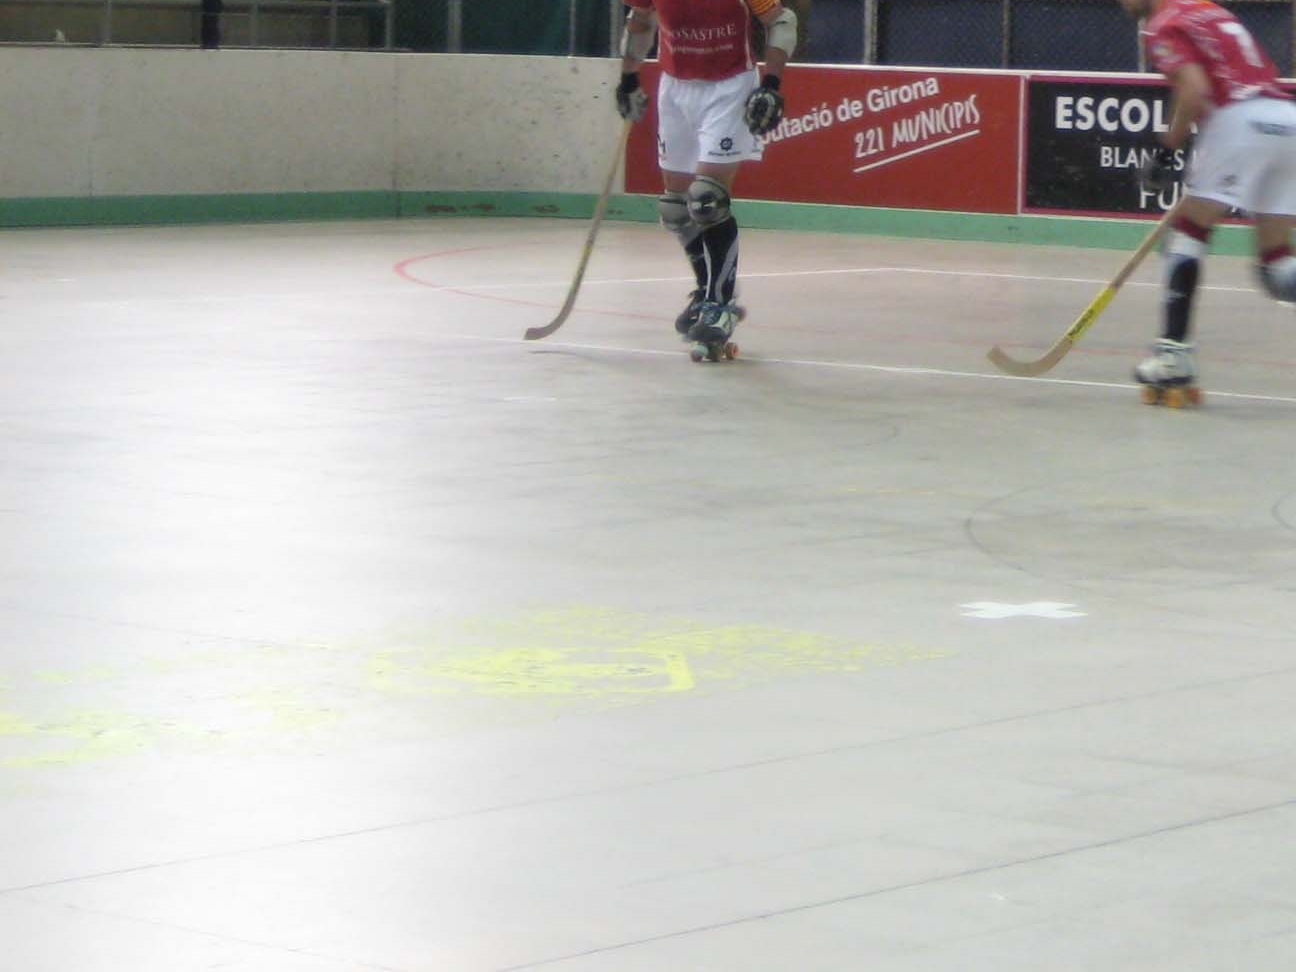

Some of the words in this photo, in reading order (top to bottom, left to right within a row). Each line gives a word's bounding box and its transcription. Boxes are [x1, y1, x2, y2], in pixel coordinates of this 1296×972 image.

[836, 97, 864, 123] de
[866, 76, 941, 113] Girona
[853, 126, 885, 160] 221
[890, 93, 981, 149] MUNICIPIS
